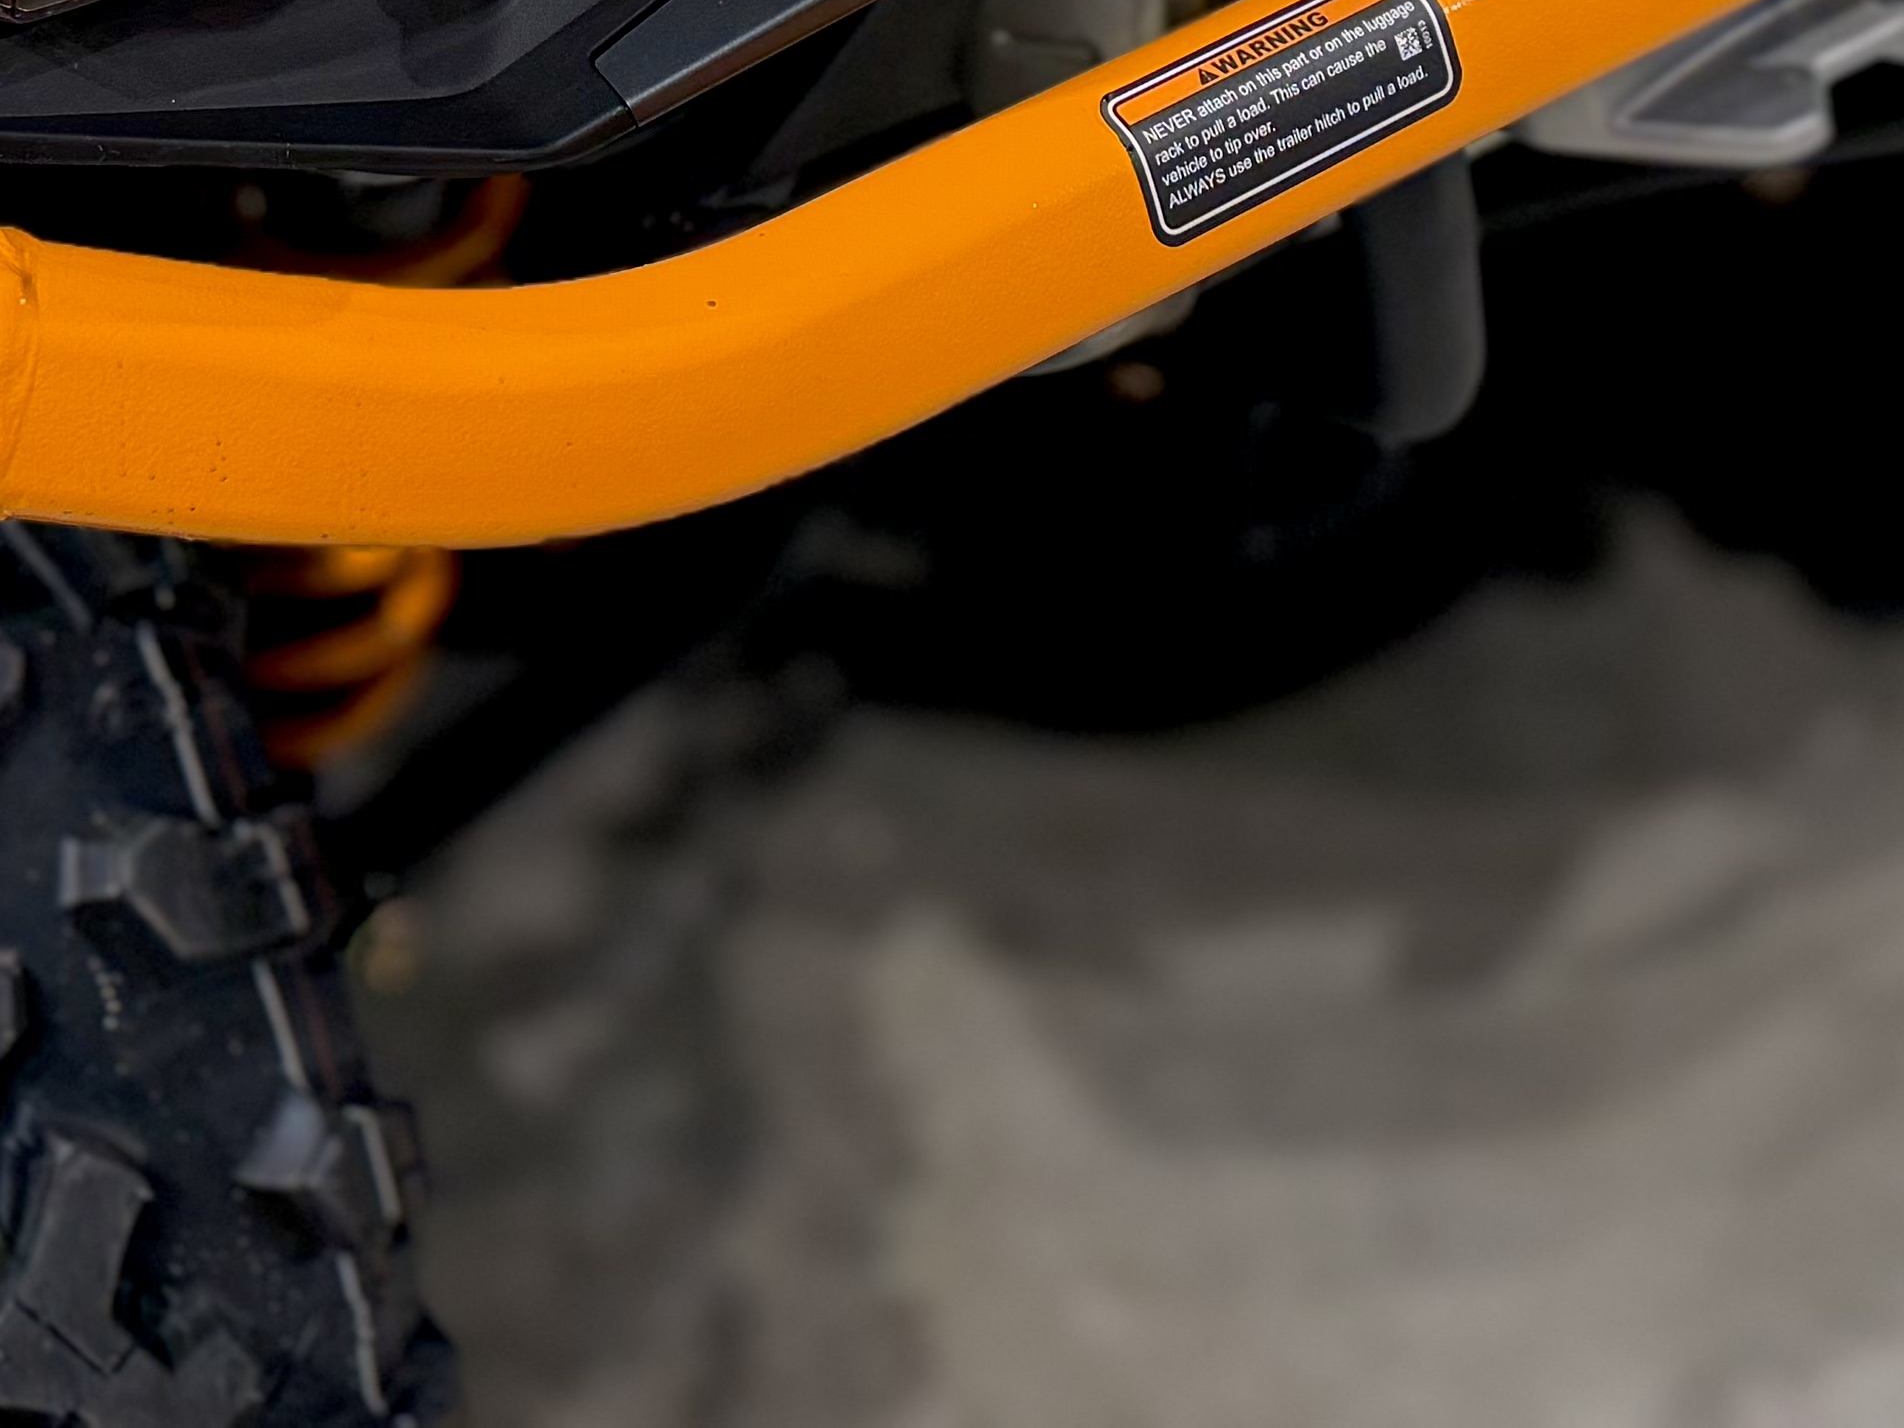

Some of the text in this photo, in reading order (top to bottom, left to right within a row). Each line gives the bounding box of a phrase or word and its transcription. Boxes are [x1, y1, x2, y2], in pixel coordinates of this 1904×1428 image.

[1142, 0, 1415, 144] NEVER attach on this part or on the luggage
[1155, 38, 1387, 166] rack to pull a load. This can cause the
[1211, 12, 1328, 75] WARNING
[1162, 120, 1276, 186] vehicle to tip over.
[1169, 65, 1429, 209] ALWAYS use the trailer hitch to pull a load.
